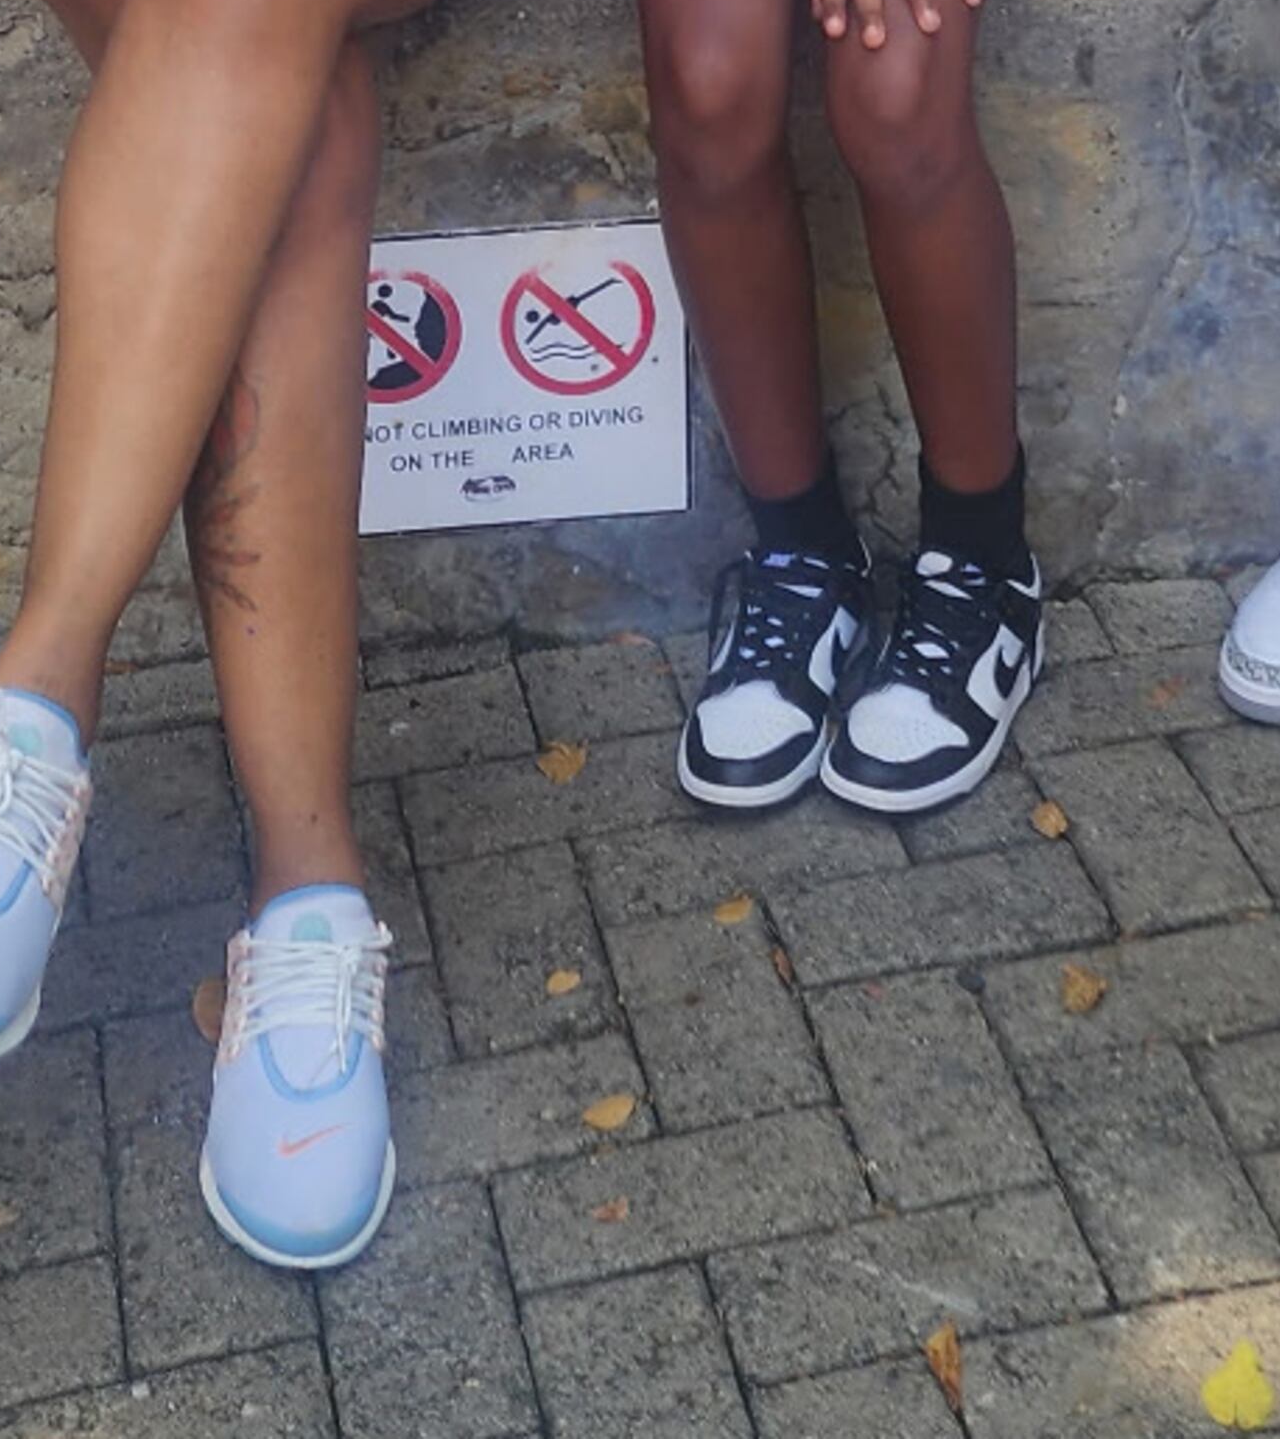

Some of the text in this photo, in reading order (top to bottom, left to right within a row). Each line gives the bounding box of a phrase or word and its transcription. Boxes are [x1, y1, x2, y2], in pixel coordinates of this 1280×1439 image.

[412, 415, 521, 440] CLIMBING
[529, 411, 562, 430] OR
[569, 406, 643, 428] DIVING
[390, 443, 574, 472] ON THE AREA
